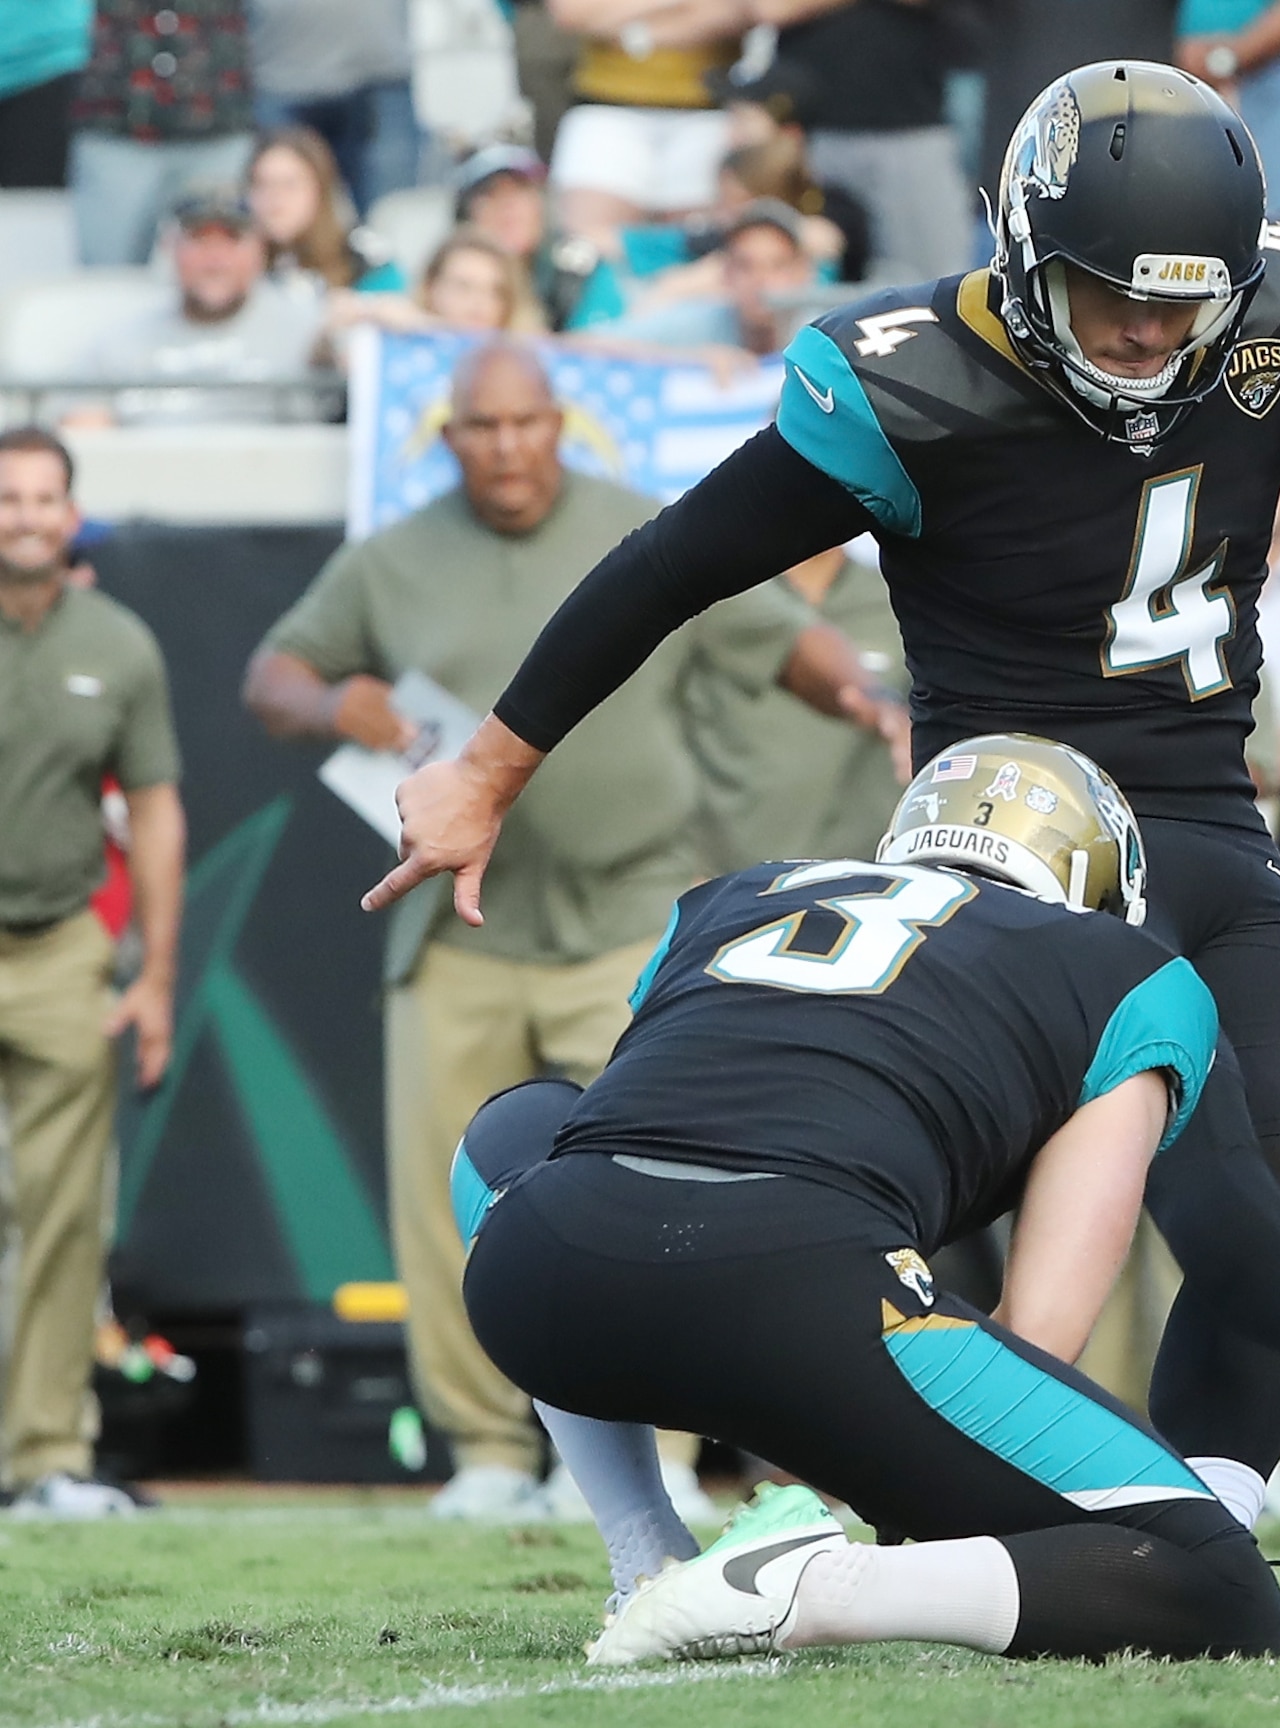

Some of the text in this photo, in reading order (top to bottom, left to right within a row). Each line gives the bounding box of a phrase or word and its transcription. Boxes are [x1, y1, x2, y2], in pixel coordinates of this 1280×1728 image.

[1159, 262, 1206, 281] JAGS
[853, 306, 940, 357] 4
[1101, 463, 1237, 703] 4
[973, 801, 995, 827] 3
[908, 829, 1010, 865] JAGUARS
[703, 860, 980, 995] 3
